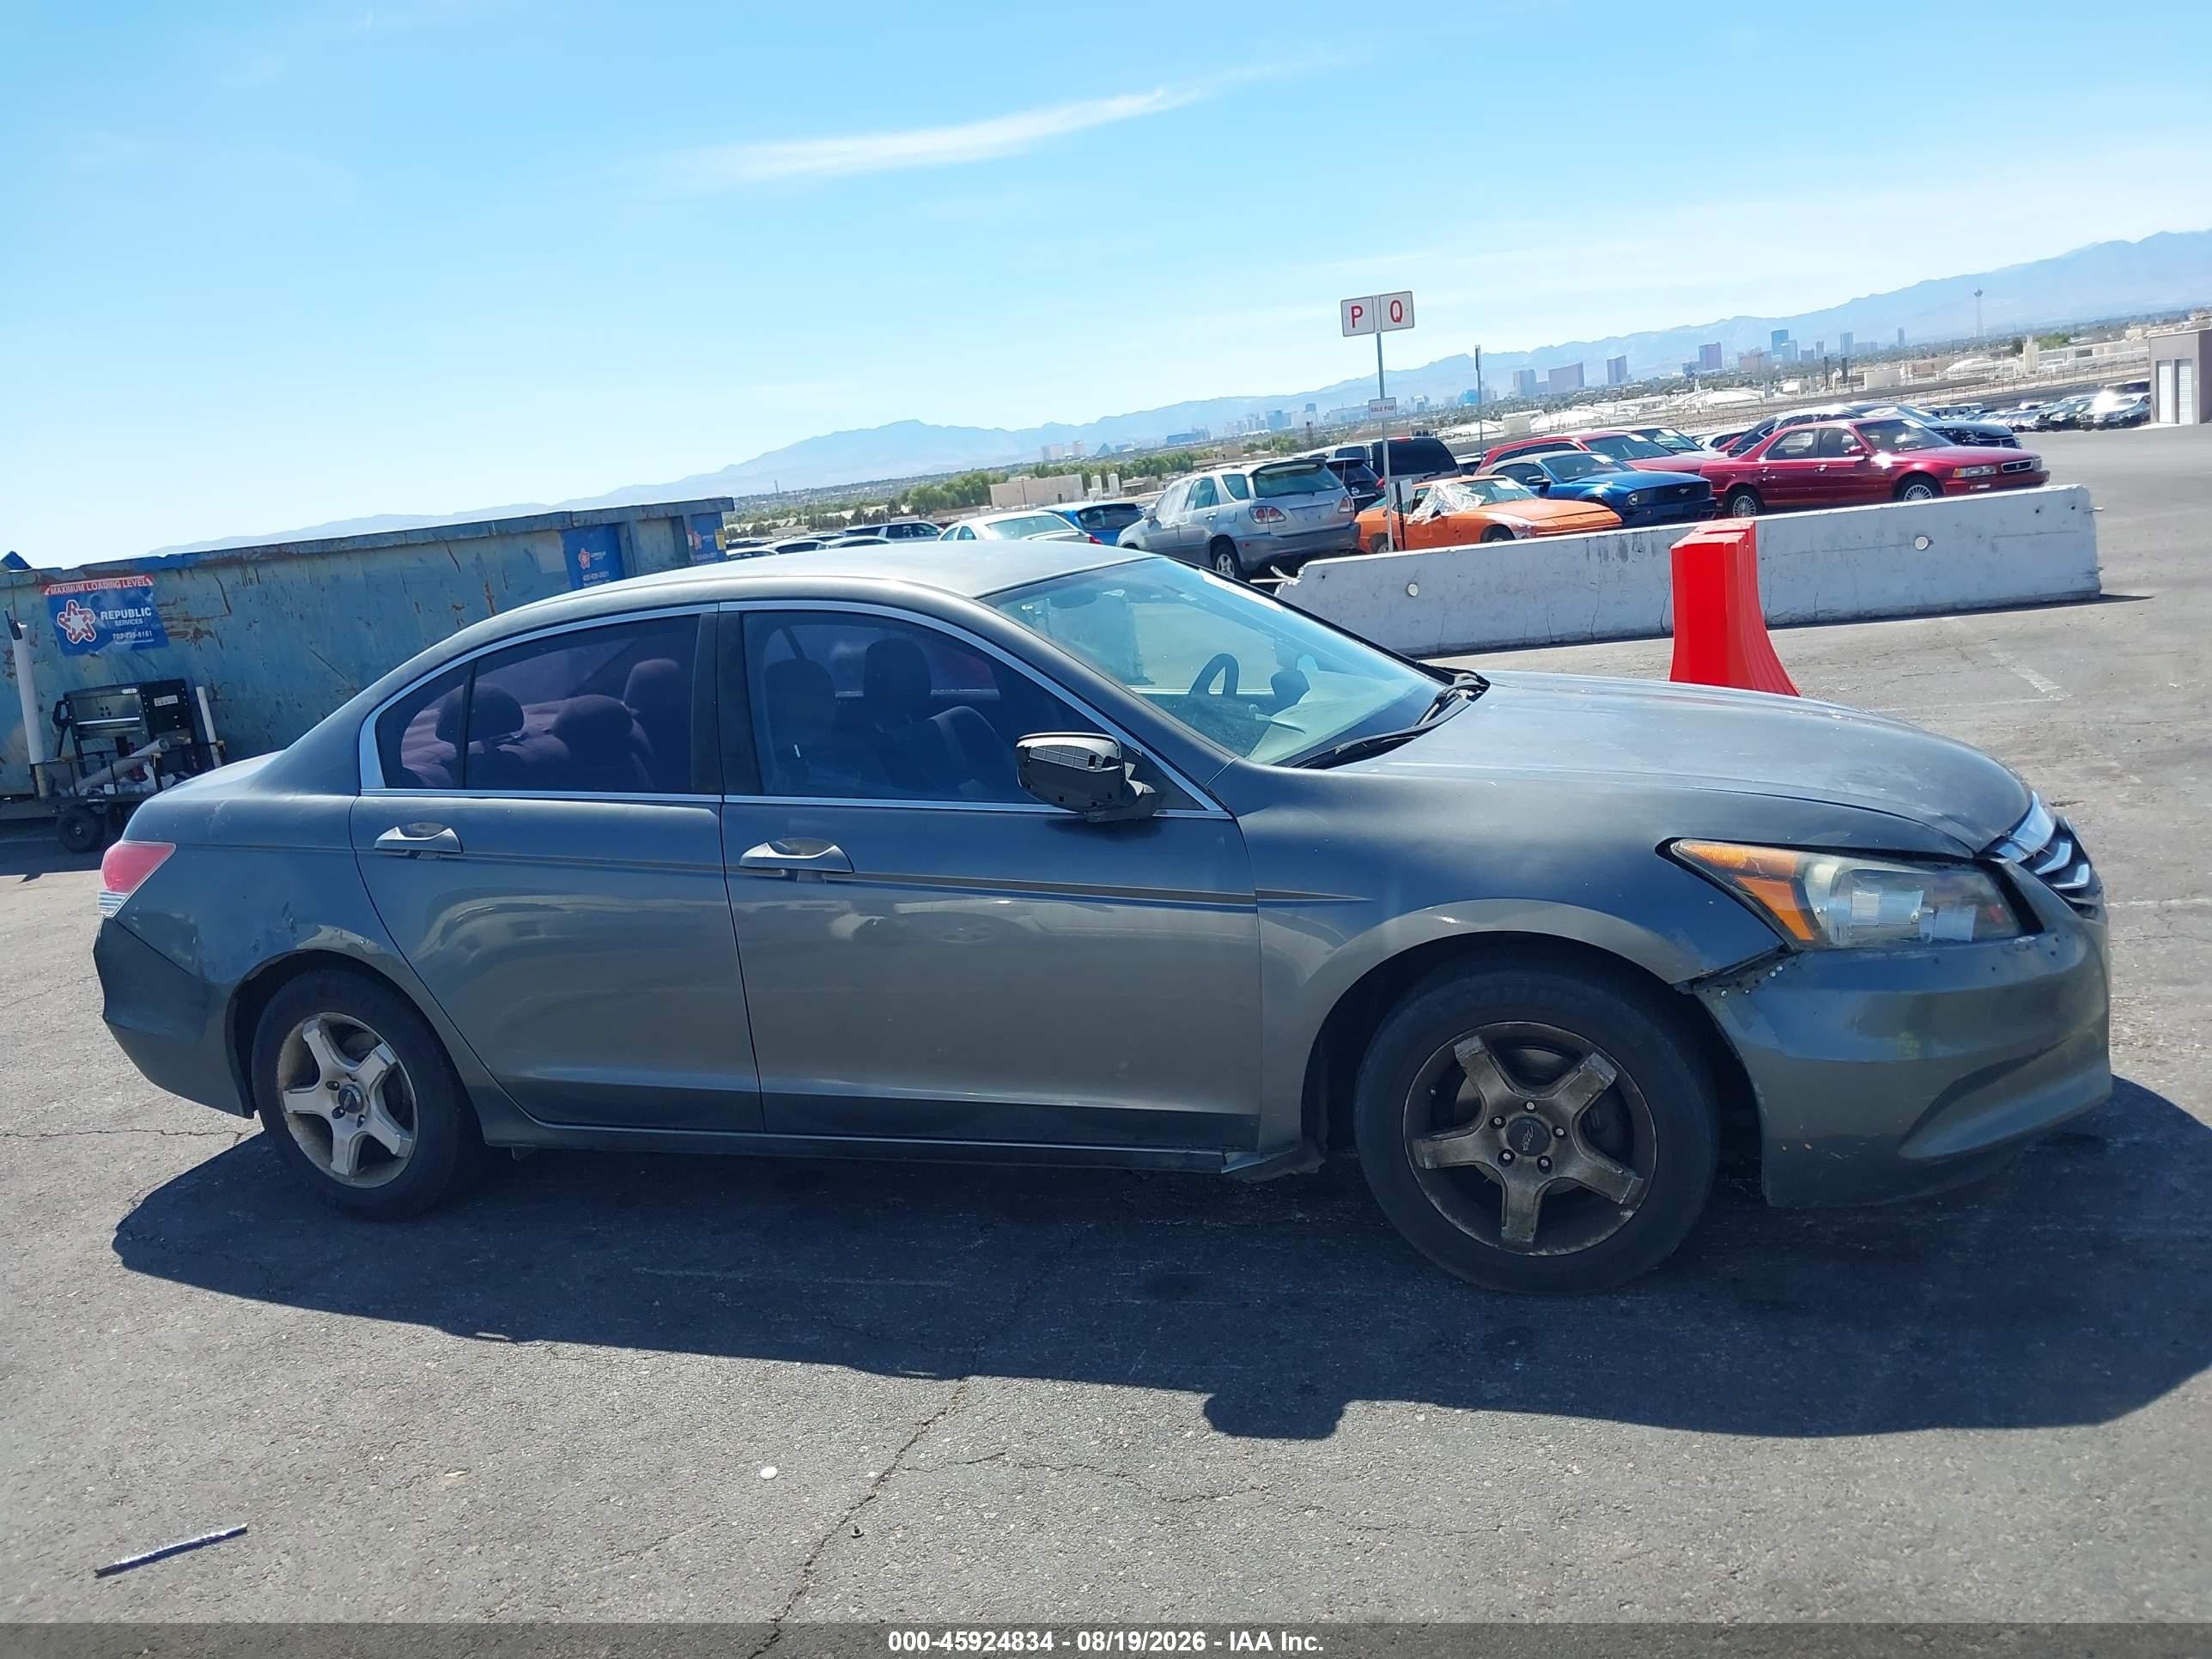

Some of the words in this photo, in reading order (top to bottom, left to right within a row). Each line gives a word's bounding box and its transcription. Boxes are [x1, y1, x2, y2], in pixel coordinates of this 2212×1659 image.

[1351, 305, 1364, 329] P
[1389, 300, 1403, 323] Q
[51, 583, 85, 595] MAXIMUM
[86, 580, 121, 592] LOADING
[123, 578, 147, 588] LEVEL
[100, 606, 152, 620] REPUBLIC
[114, 617, 143, 627] SERVICES
